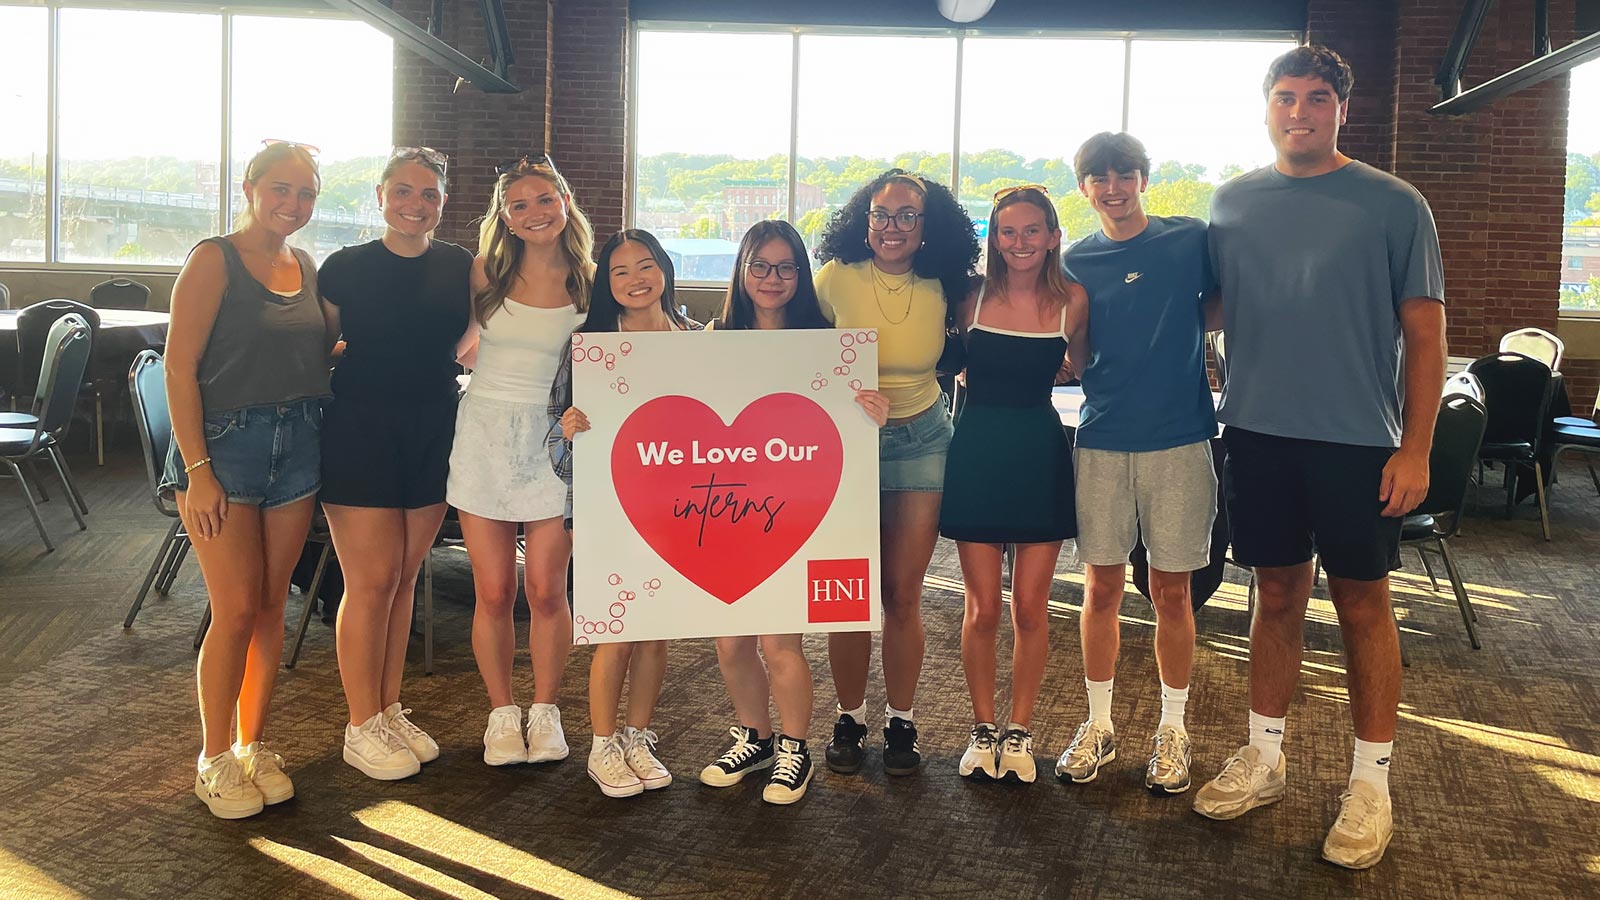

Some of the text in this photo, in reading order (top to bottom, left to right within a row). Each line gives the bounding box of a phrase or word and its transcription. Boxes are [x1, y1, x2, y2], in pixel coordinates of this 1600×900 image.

[637, 438, 818, 465] We Love Our
[673, 473, 786, 547] interns
[812, 578, 865, 602] HNI
